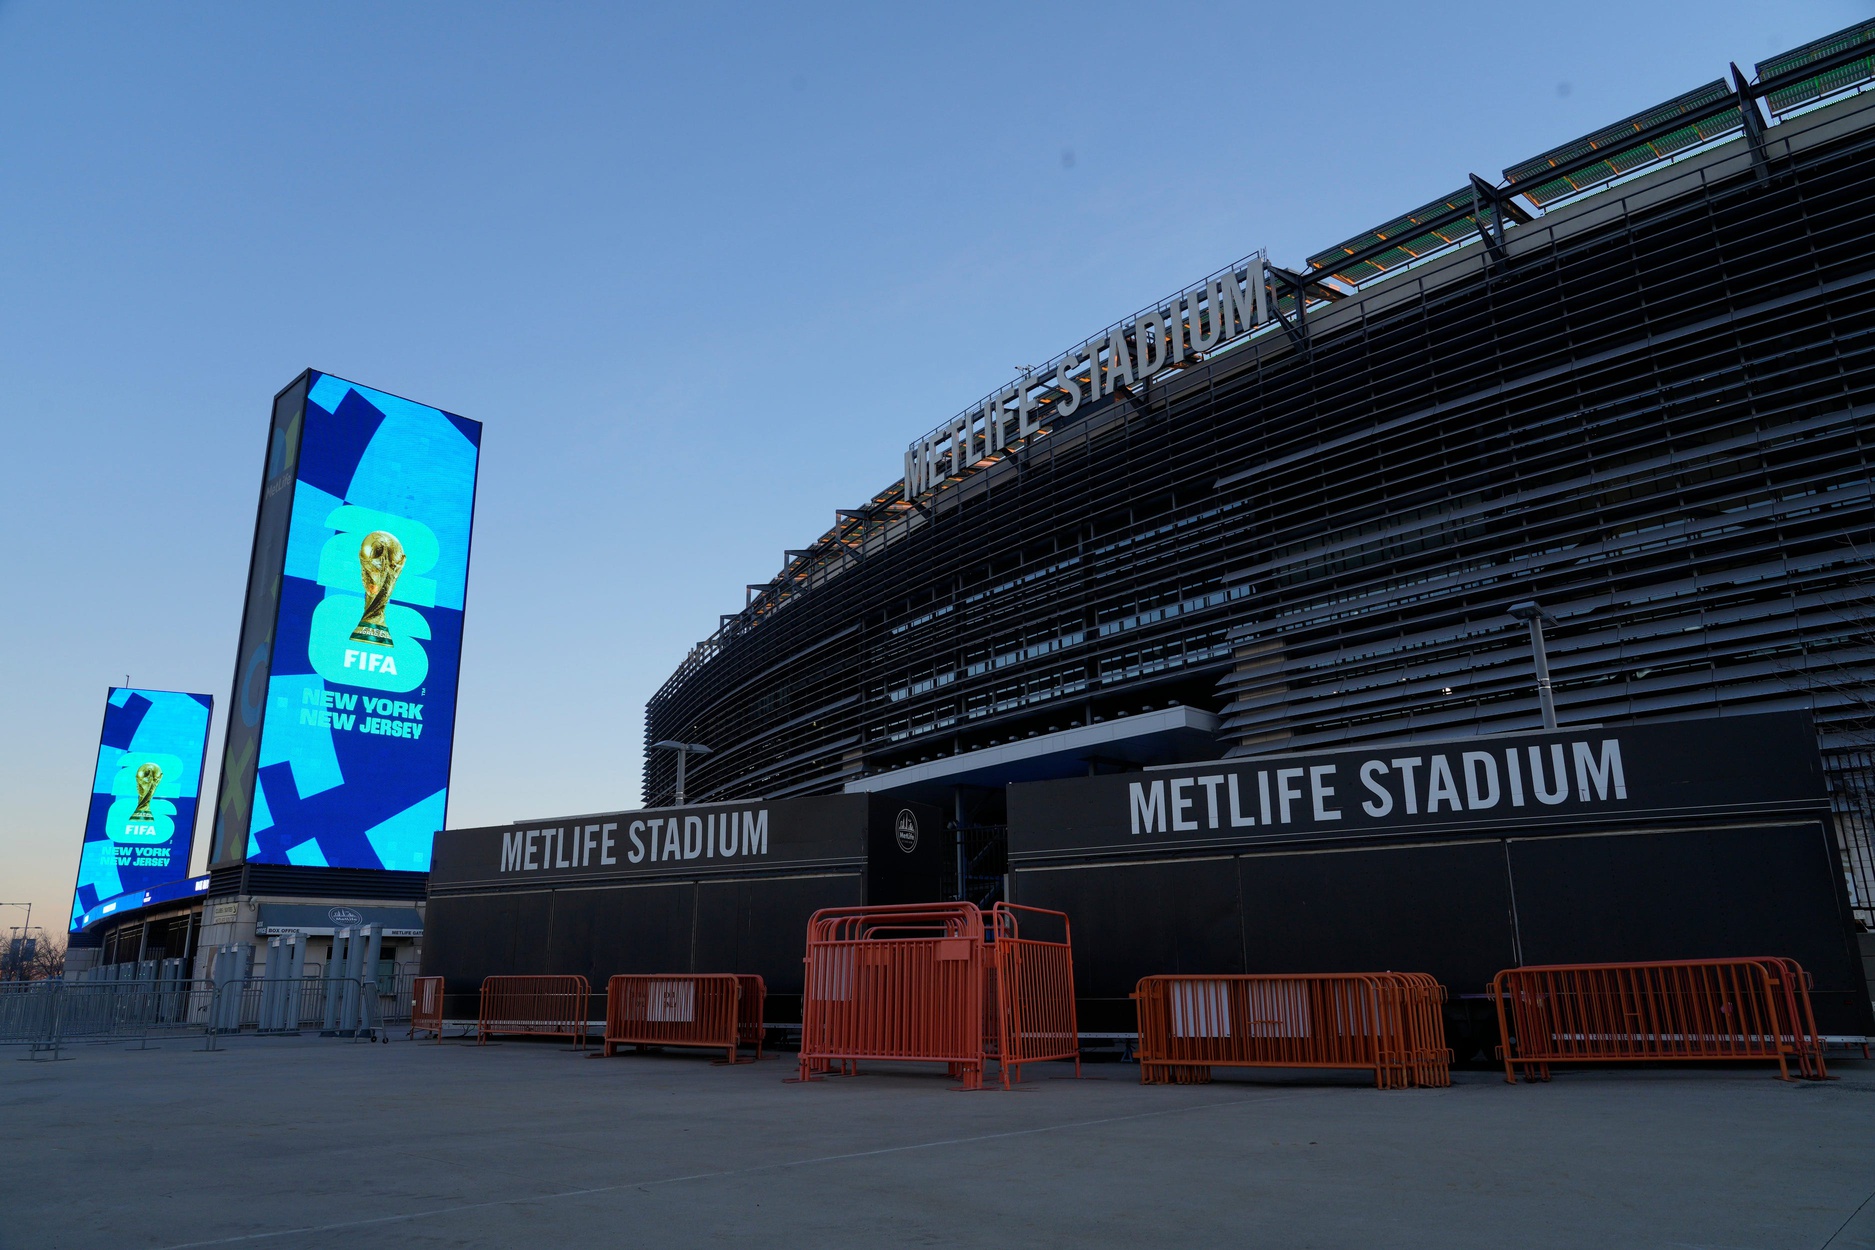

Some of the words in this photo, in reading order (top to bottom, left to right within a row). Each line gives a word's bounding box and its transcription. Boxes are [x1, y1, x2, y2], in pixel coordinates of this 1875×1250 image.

[904, 375, 1041, 501] METLIFE
[1056, 257, 1269, 417] STADIUM
[343, 649, 398, 676] FIFA
[302, 687, 358, 711] NEW
[362, 696, 424, 721] YORK
[299, 708, 356, 731] NEW
[359, 717, 423, 740] JERSEY
[1128, 764, 1342, 835] METLIFE
[1359, 739, 1628, 818] STADIUM
[125, 825, 157, 836] FIFA
[500, 822, 618, 872] METLIFE
[627, 809, 769, 864] STADIUM
[100, 856, 131, 867] NEW
[133, 857, 171, 867] JERSEY
[101, 846, 133, 856] NEW
[135, 847, 171, 857] YORK
